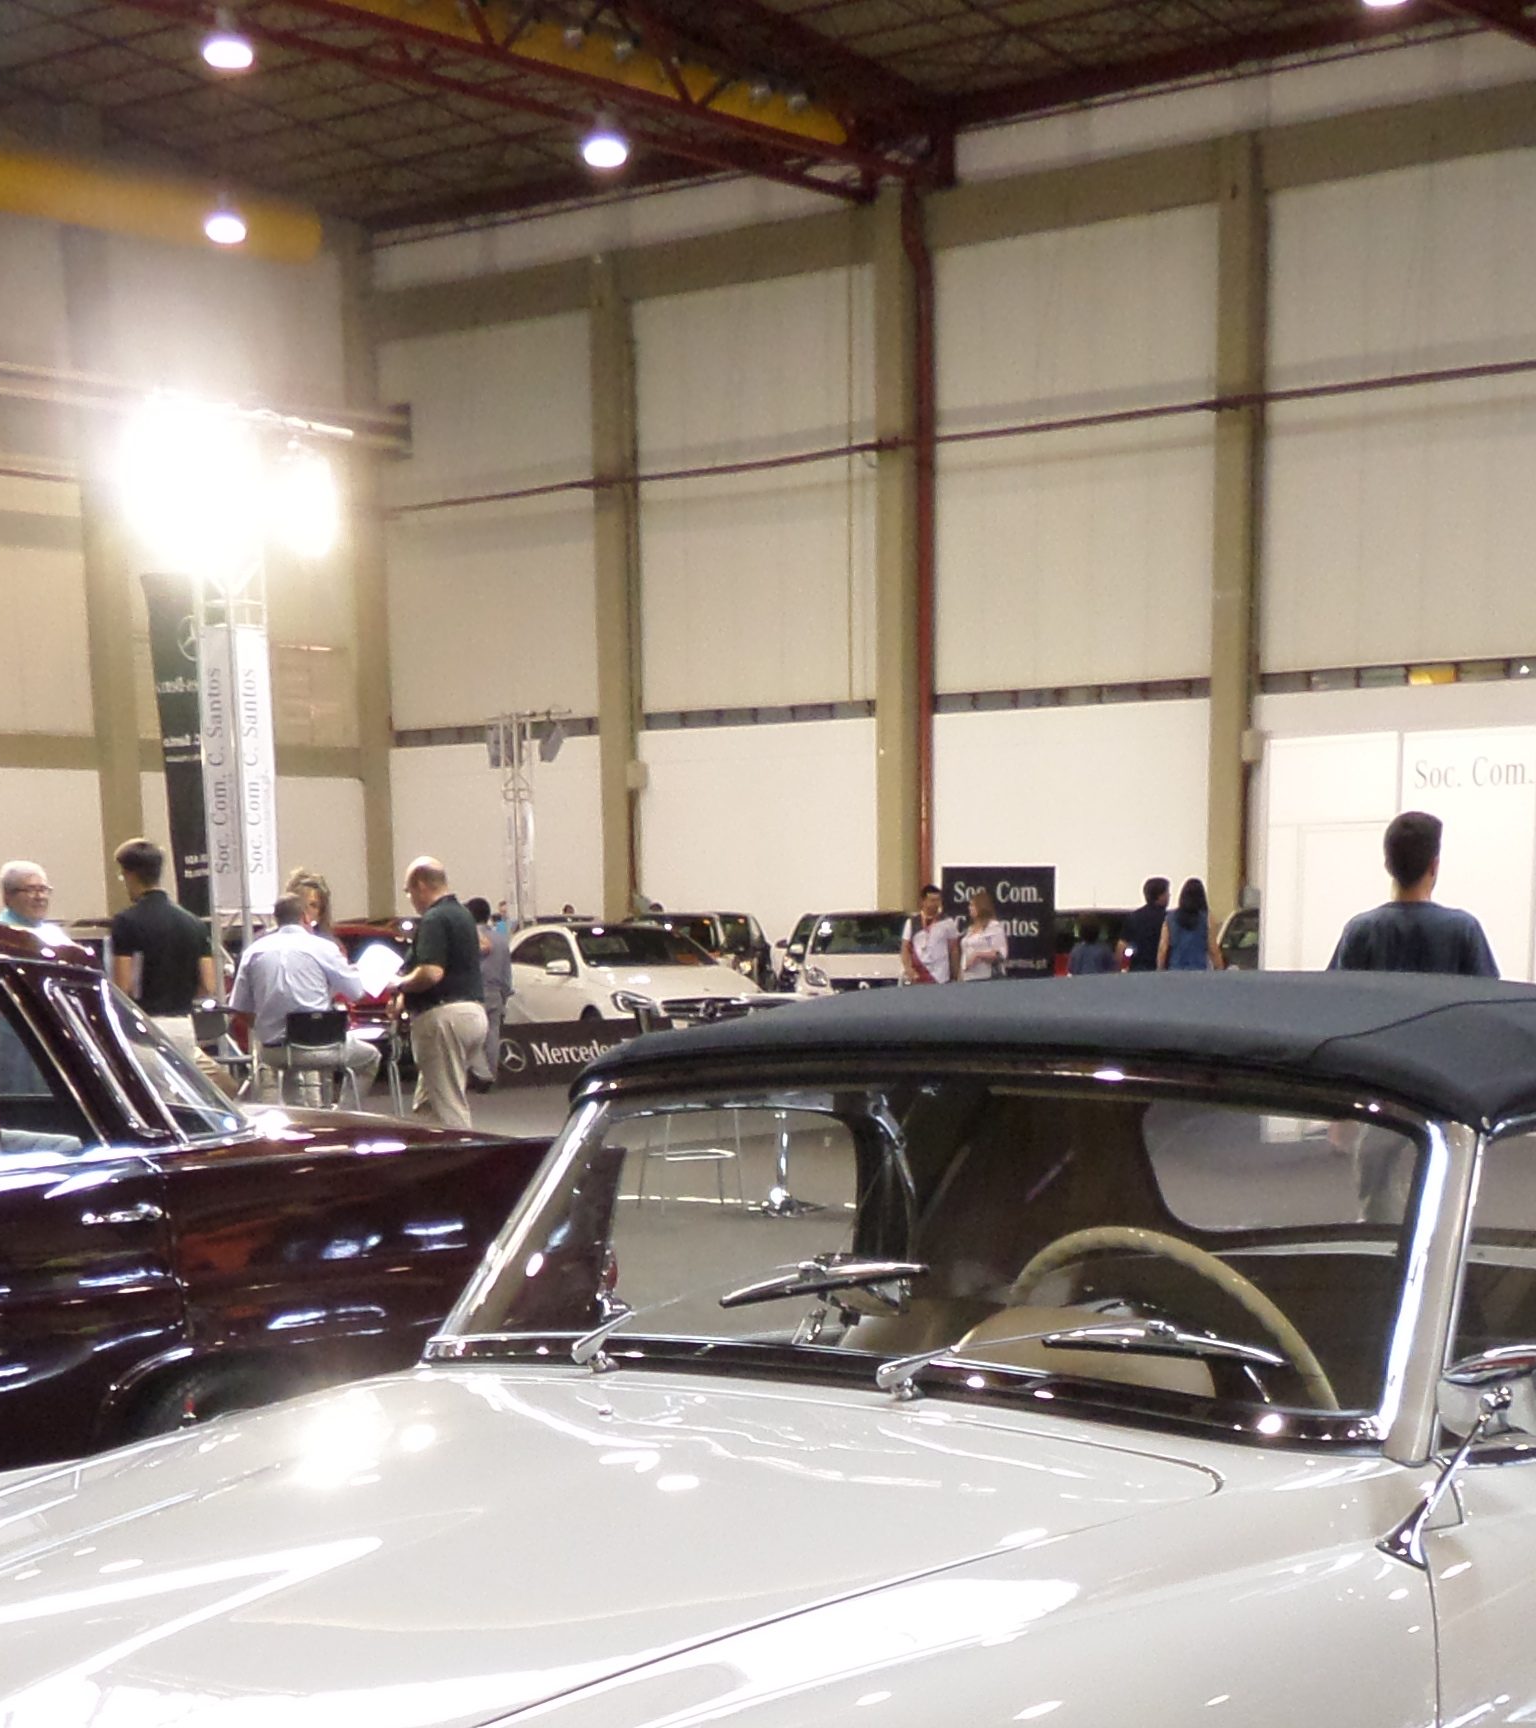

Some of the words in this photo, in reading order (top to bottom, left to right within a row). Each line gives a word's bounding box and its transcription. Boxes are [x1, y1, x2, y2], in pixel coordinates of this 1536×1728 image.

[206, 666, 223, 741] Santos
[241, 668, 258, 741] Santos
[1414, 759, 1462, 790] Soc.
[1472, 756, 1534, 788] Com.
[996, 880, 1044, 903] Com.
